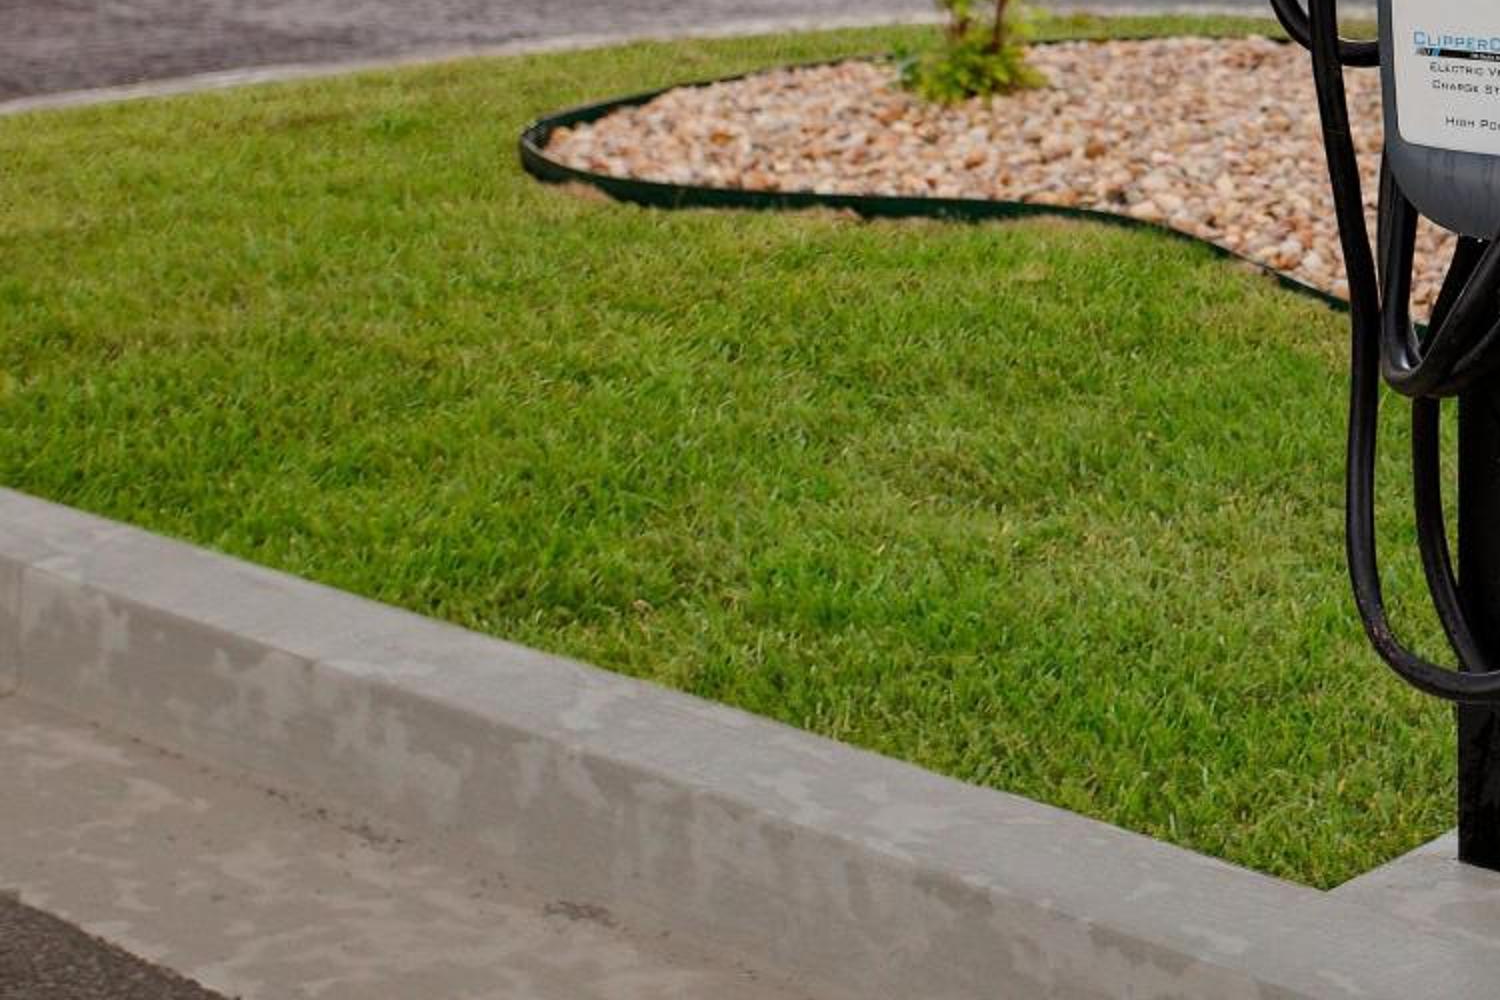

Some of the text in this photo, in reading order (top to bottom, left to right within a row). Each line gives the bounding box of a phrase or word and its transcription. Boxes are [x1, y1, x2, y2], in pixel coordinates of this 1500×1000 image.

[1429, 61, 1484, 77] ELECTRIC
[1431, 79, 1479, 93] CHARGE
[1445, 116, 1475, 128] HIGH
